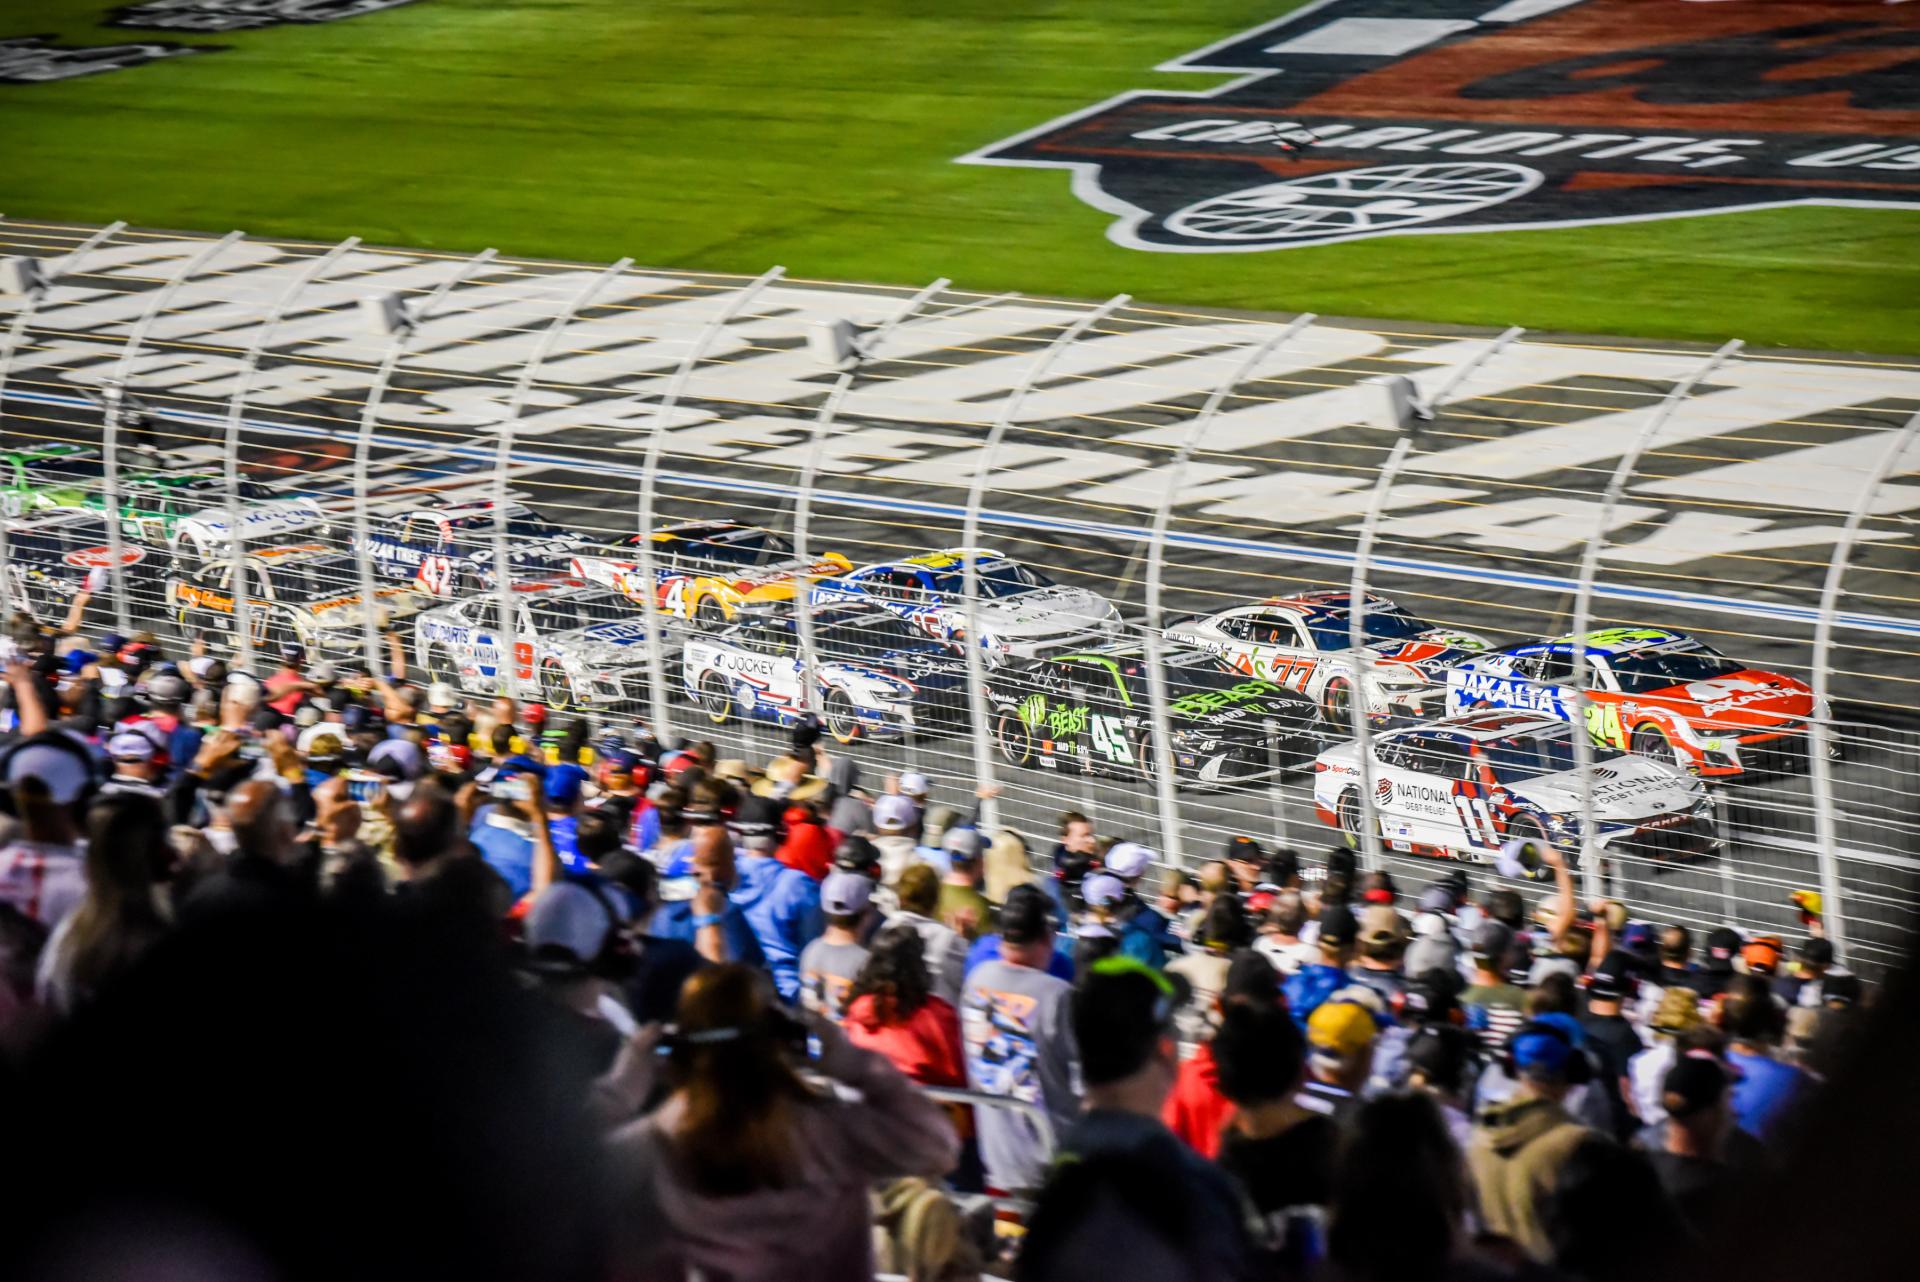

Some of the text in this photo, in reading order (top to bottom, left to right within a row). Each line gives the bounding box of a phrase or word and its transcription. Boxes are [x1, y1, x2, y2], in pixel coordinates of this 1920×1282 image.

[1786, 143, 1920, 171] US
[358, 386, 1914, 566] SPEEDWAY
[422, 555, 451, 596] 42
[664, 579, 686, 617] 4
[514, 641, 533, 680] 9
[727, 655, 776, 675] JOCKEY
[1271, 654, 1319, 697] 77
[1168, 679, 1281, 723] BEAST
[1464, 672, 1556, 715] AXALTA
[1701, 687, 1801, 718] AXALTA
[1050, 706, 1089, 739] BEAST
[1092, 713, 1134, 765] 45
[1199, 740, 1217, 751] 45
[1397, 783, 1452, 805] NATIONAL
[1405, 801, 1447, 816] DEBT RELIEF
[1599, 789, 1635, 805] DEBT
[1453, 794, 1502, 846] 11
[1639, 814, 1693, 830] CAMRY
